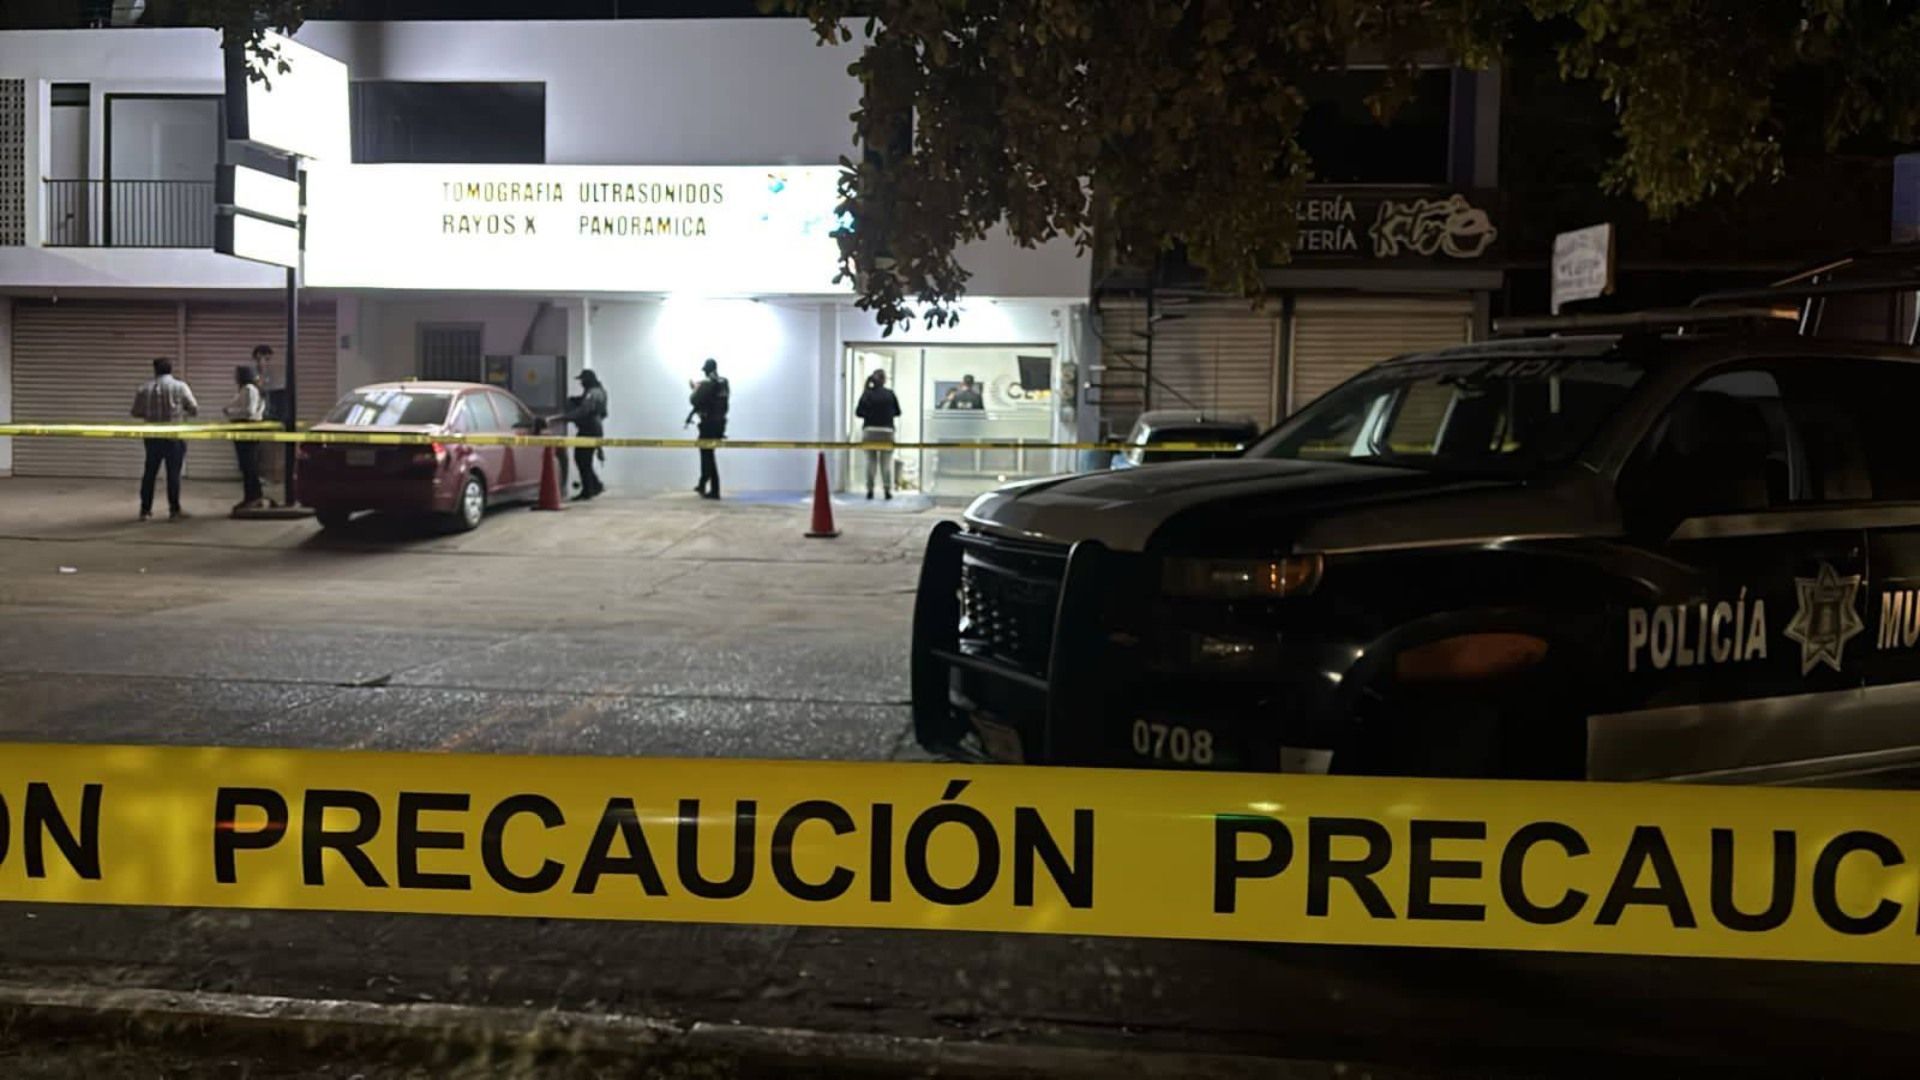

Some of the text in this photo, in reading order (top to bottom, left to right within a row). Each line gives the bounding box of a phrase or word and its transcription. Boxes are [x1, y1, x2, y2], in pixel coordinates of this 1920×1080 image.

[442, 182, 723, 204] TOMOGRAFIA ULTRASONIDOS
[1296, 195, 1356, 221] LERÍA
[442, 214, 706, 237] RAYOS X PANORAMICA
[1297, 225, 1358, 250] TERÍA
[1627, 585, 1767, 672] POLICÍA
[1132, 719, 1214, 765] 0708
[0, 780, 1920, 936] N PRECAUCIÓN PRECAUC
